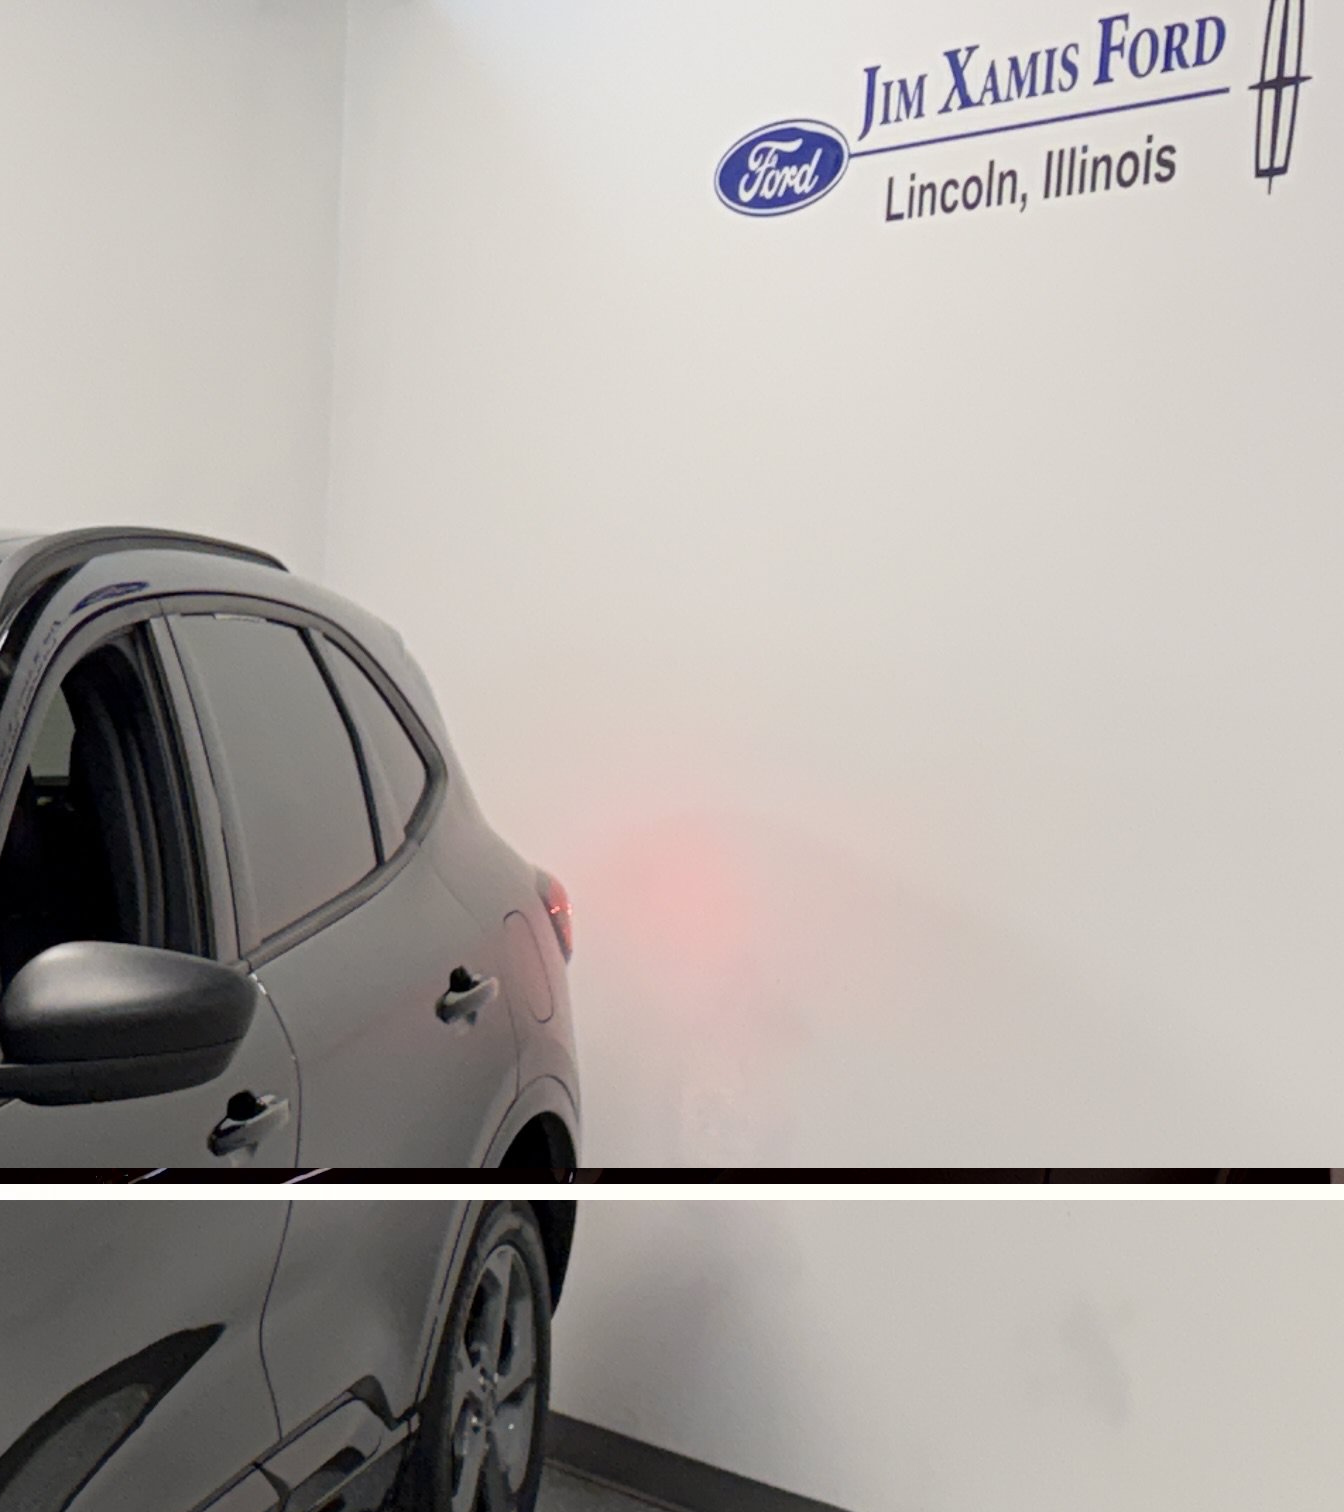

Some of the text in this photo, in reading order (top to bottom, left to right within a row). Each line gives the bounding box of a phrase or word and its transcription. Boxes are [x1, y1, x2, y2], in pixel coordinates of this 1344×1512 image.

[738, 138, 823, 202] Ford
[885, 135, 1177, 222] Lincoln, Illinois
